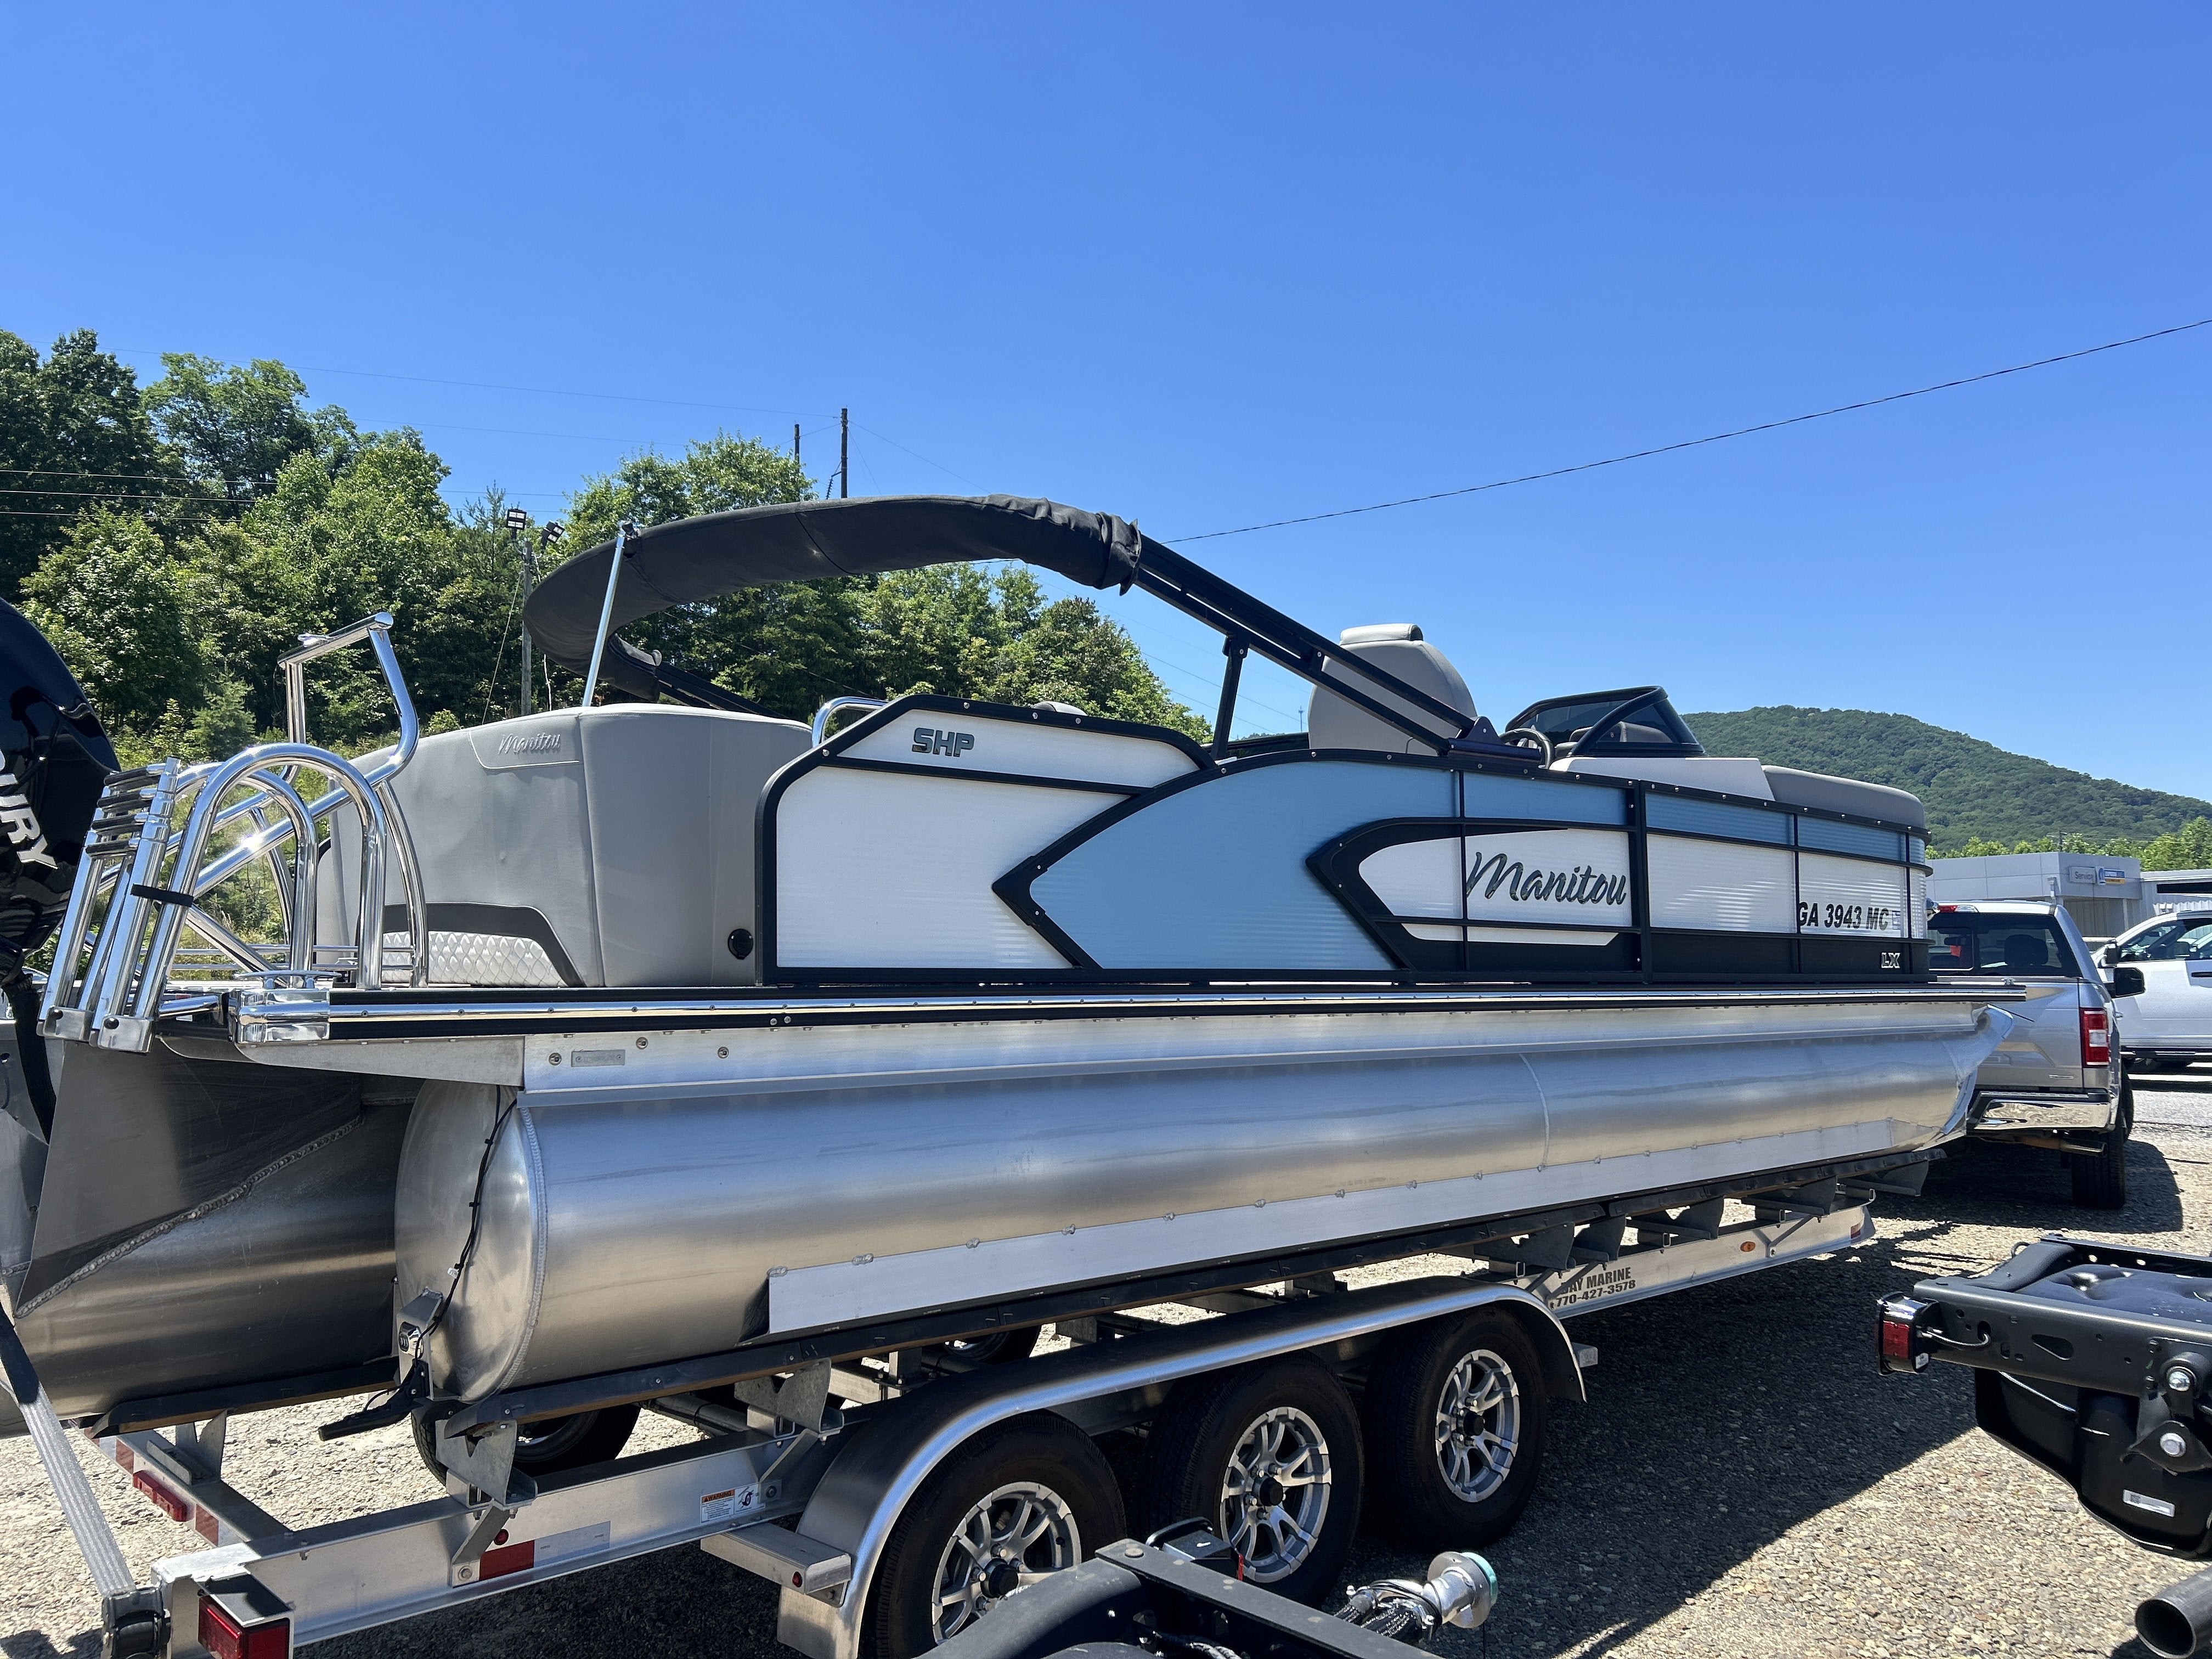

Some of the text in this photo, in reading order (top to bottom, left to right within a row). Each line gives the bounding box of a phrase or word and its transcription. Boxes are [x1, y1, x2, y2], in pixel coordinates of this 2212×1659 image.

[498, 732, 561, 754] Manitou
[912, 727, 975, 757] SHP
[1466, 851, 1627, 905] Manitou
[1799, 901, 1819, 927] GA
[1824, 904, 1862, 929] 3943
[1866, 907, 1889, 931] MC
[1881, 952, 1900, 969] LX
[1587, 1267, 1631, 1289] MARINE
[1556, 1279, 1636, 1307] 770-427-3578
